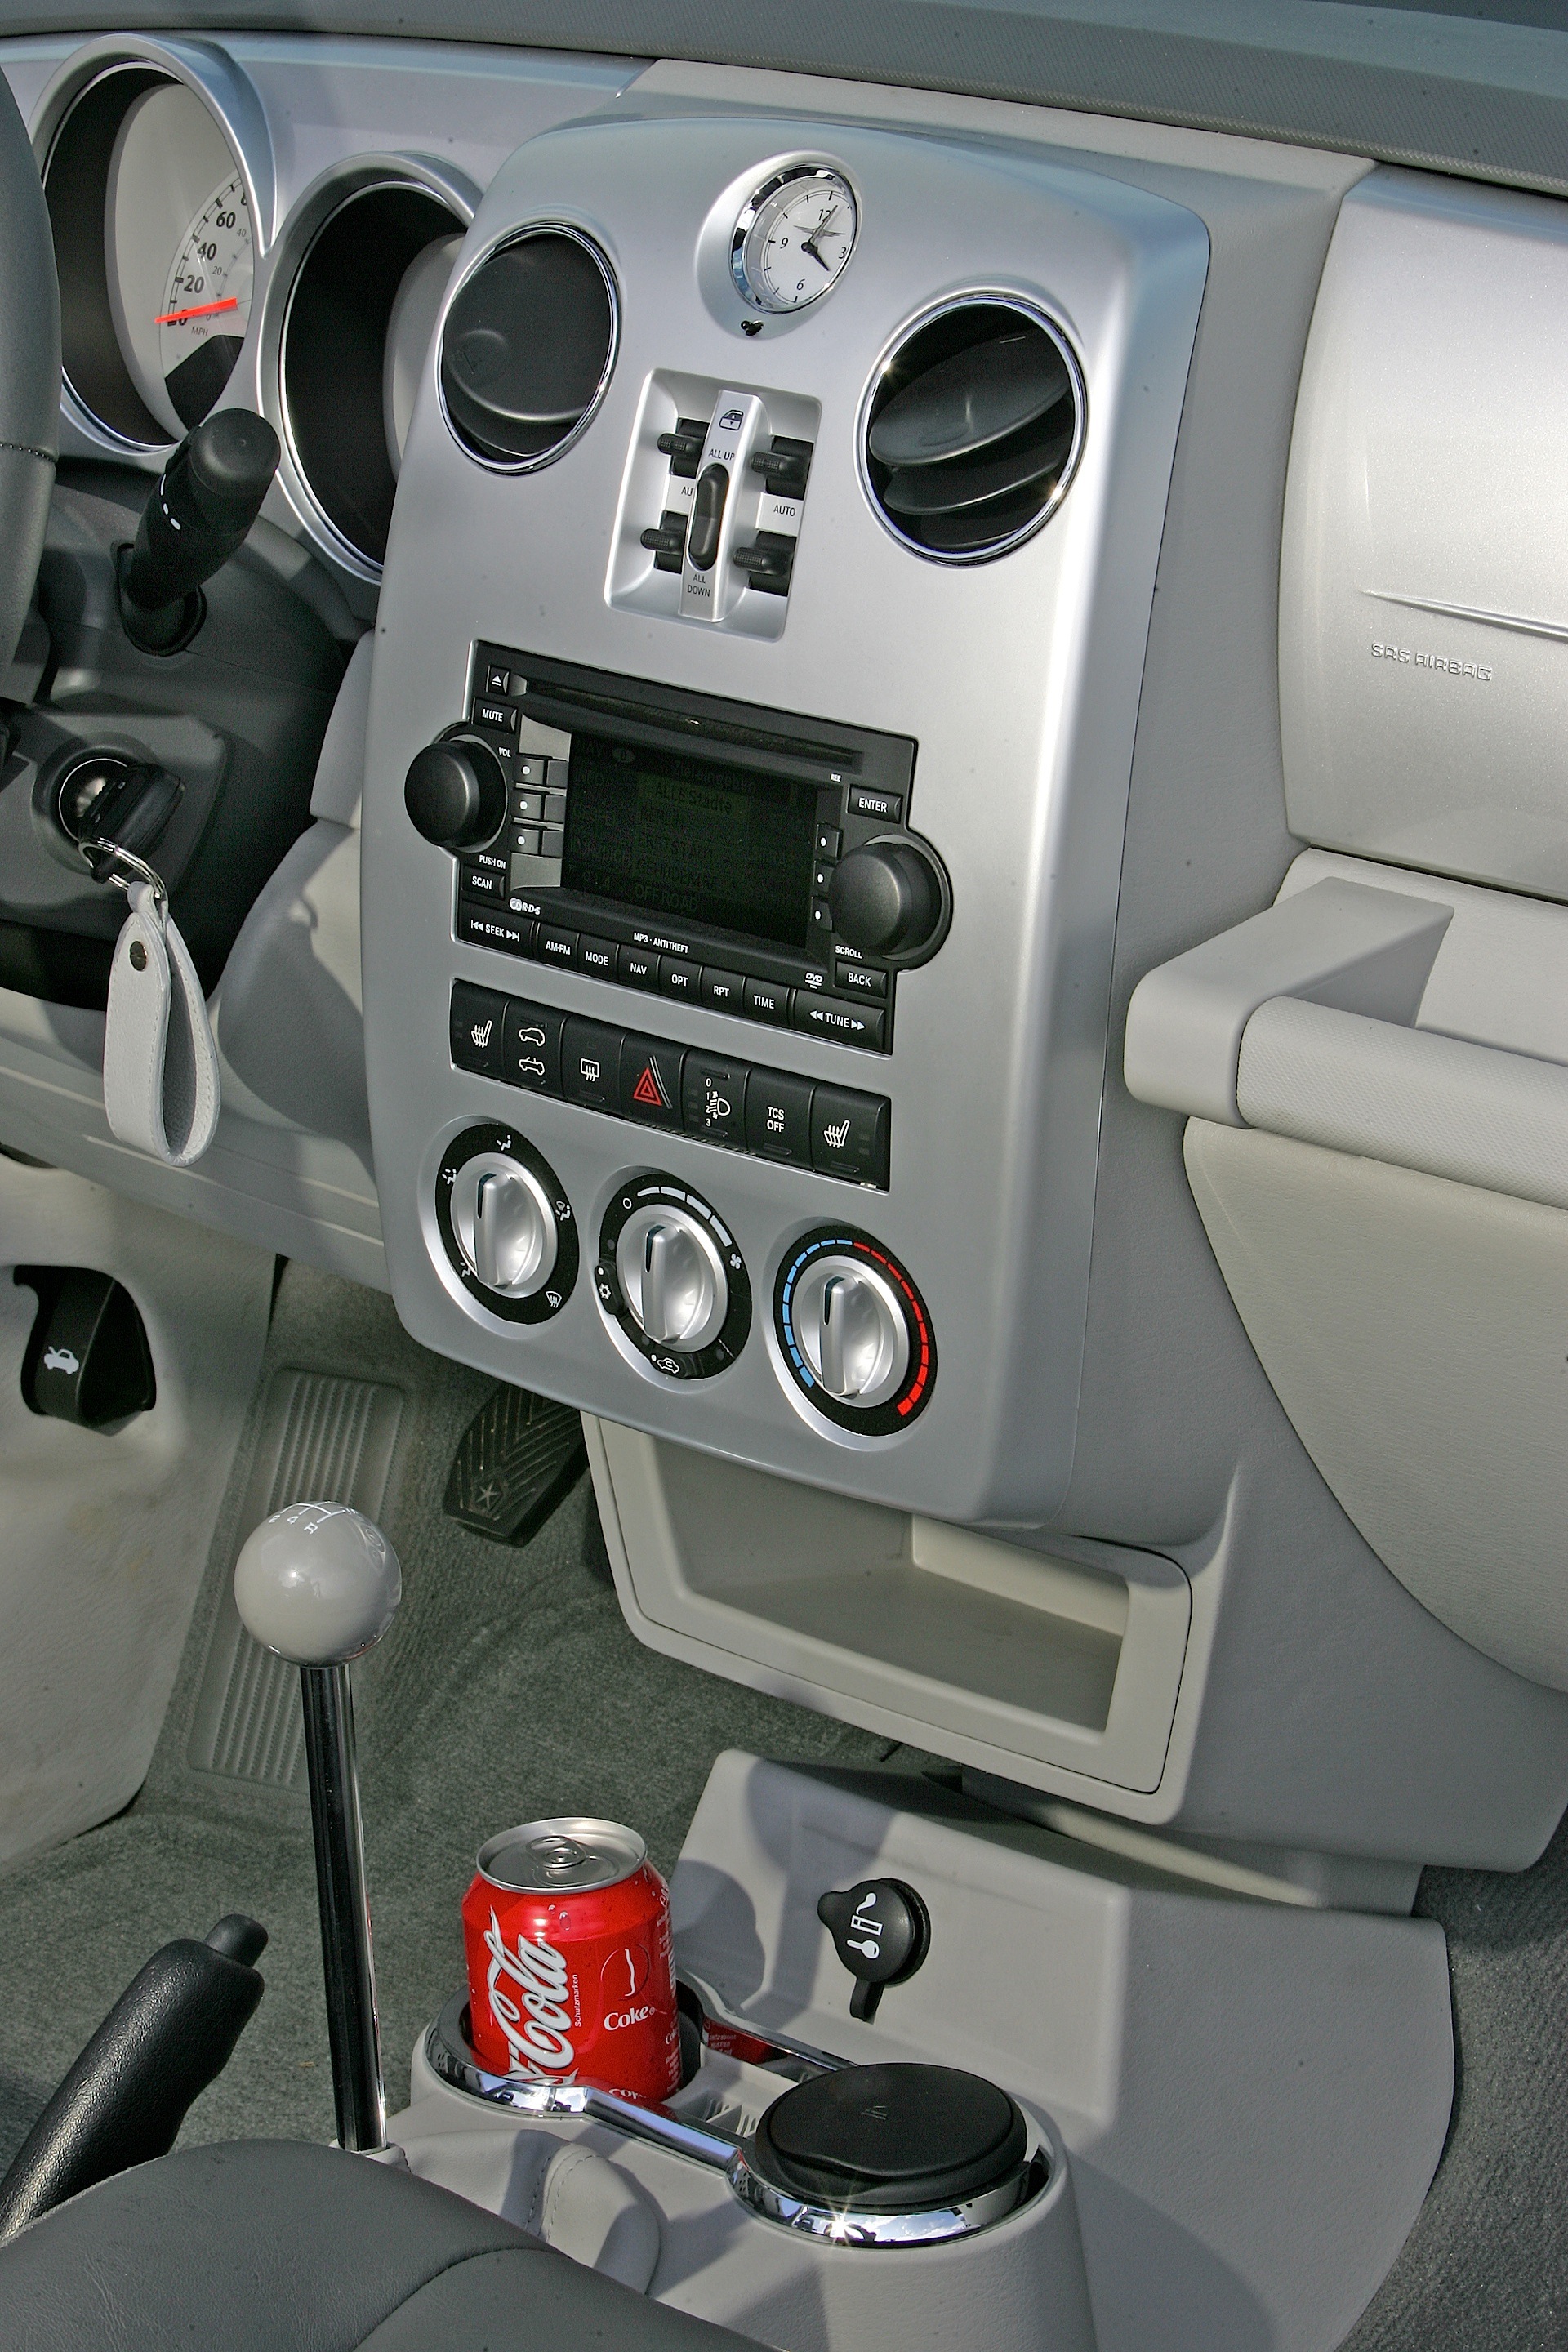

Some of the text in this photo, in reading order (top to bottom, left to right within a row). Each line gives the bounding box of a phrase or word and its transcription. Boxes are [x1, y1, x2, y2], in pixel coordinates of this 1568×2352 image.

[216, 211, 236, 229] 60
[237, 228, 247, 238] 40
[779, 237, 789, 249] 9
[197, 242, 217, 261] 40
[838, 246, 846, 260] 3
[212, 265, 223, 276] 20
[183, 274, 204, 294] 20
[796, 278, 806, 291] 6
[191, 327, 208, 336] MPH
[708, 448, 735, 461] ALL UP
[681, 486, 693, 497] AU
[773, 504, 796, 517] AUTO
[693, 573, 706, 584] ALL
[687, 585, 710, 597] DOWN
[1371, 642, 1493, 681] SRS AIRBAG
[482, 708, 504, 723] MUTE
[498, 746, 511, 758] VOL
[858, 797, 888, 813] ENTER
[479, 854, 506, 869] PUSH ON
[471, 875, 492, 890] SCAN
[485, 924, 505, 938] SEEK
[634, 932, 689, 954] MP3 ANTITHEFT
[585, 951, 608, 966] MODE
[835, 945, 863, 960] SCROLL
[630, 962, 648, 975] NAV
[671, 973, 688, 987] OPT
[848, 972, 872, 987] BACK
[713, 985, 730, 998] RPT
[753, 995, 775, 1009] TIME
[825, 1012, 850, 1028] TUNE
[706, 1078, 712, 1088] 0
[706, 1091, 710, 1101] 1
[705, 1105, 710, 1114] 2
[767, 1106, 785, 1120] TCS
[706, 1118, 711, 1127] 3
[766, 1120, 785, 1133] OFF
[483, 1904, 574, 2069] Cola
[572, 1974, 581, 2028] Schutzmarken
